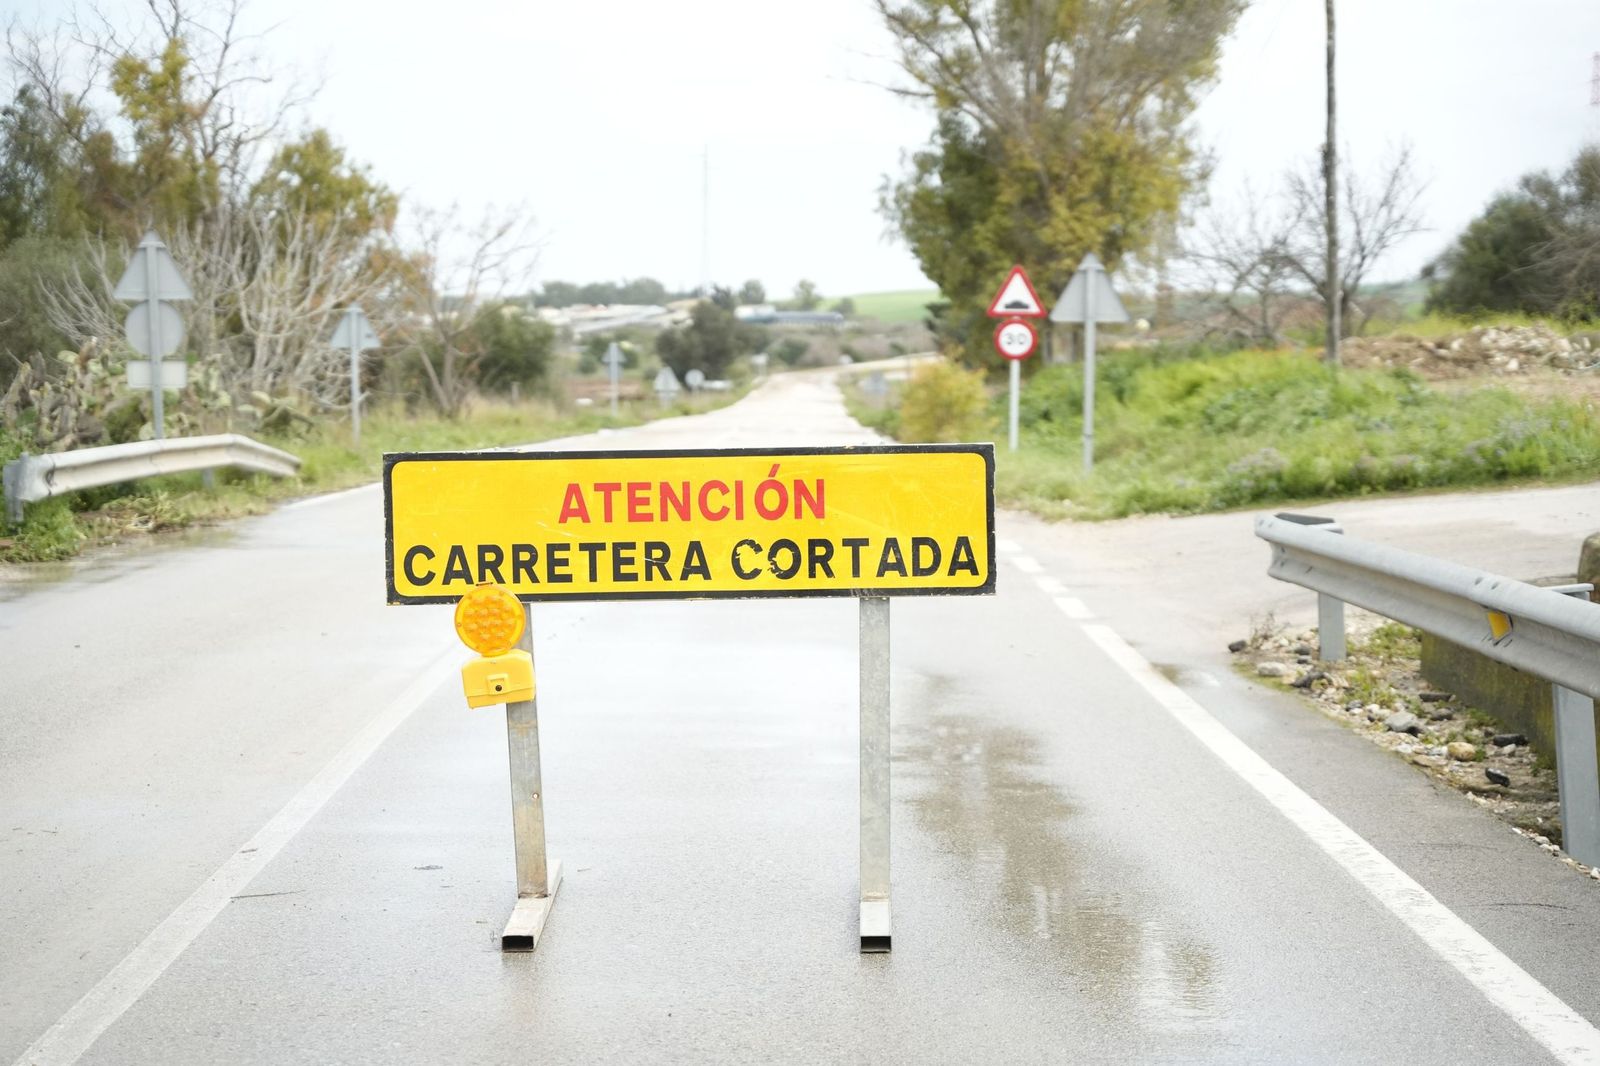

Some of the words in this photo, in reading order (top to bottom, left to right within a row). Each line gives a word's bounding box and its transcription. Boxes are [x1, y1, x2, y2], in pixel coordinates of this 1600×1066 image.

[1005, 332, 1027, 346] 30
[558, 463, 825, 524] ATENCIÓN
[403, 540, 712, 587] CARRETERA
[731, 535, 980, 581] CORTADA
